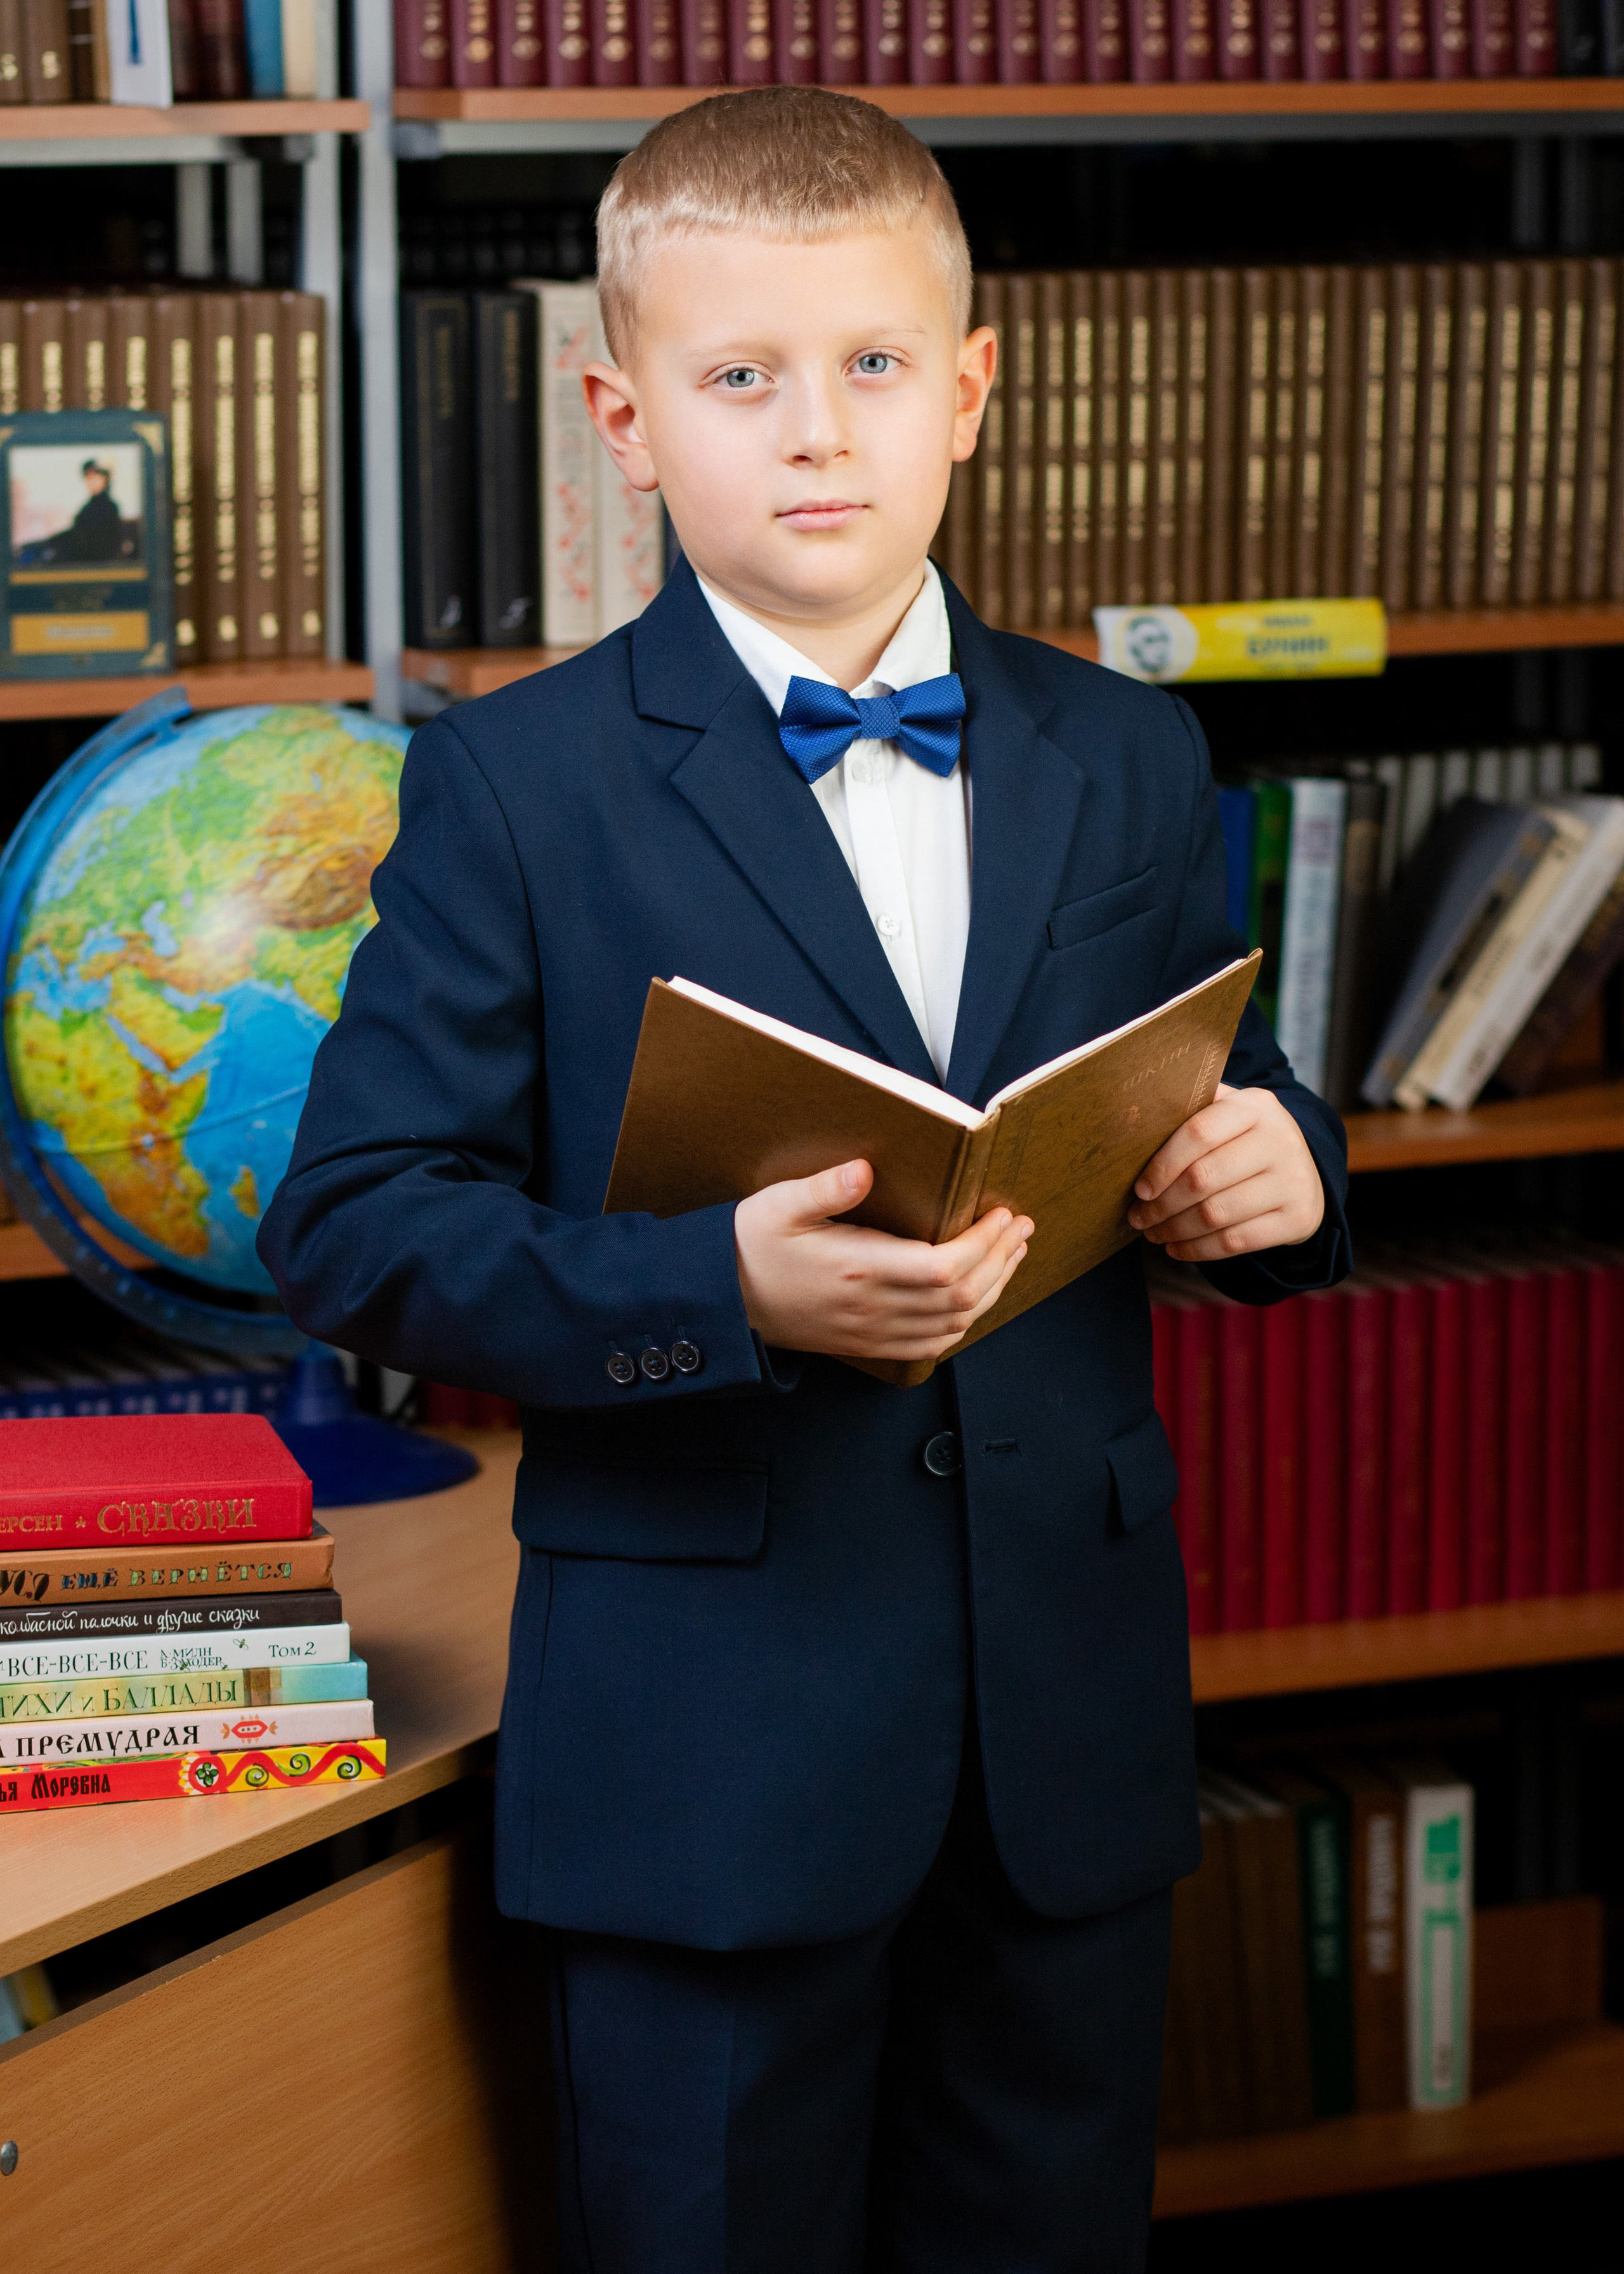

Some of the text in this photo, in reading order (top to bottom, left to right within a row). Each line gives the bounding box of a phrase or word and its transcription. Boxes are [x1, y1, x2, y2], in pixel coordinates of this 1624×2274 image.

[97, 1498, 257, 1537] СКАЗКИ
[60, 1568, 119, 1591] ЕЩЁ
[127, 1561, 293, 1587] ВЕРНЁТСЯ
[1, 1608, 260, 1635] колбасной палочки и другие сказки
[304, 1641, 317, 1655] 2
[8, 1650, 148, 1677] ВСЕ-ВСЕ-ВСЕ
[102, 1680, 238, 1711] БАЛЛАДЫ
[16, 1725, 200, 1757] ПРЕМУДРАЯ
